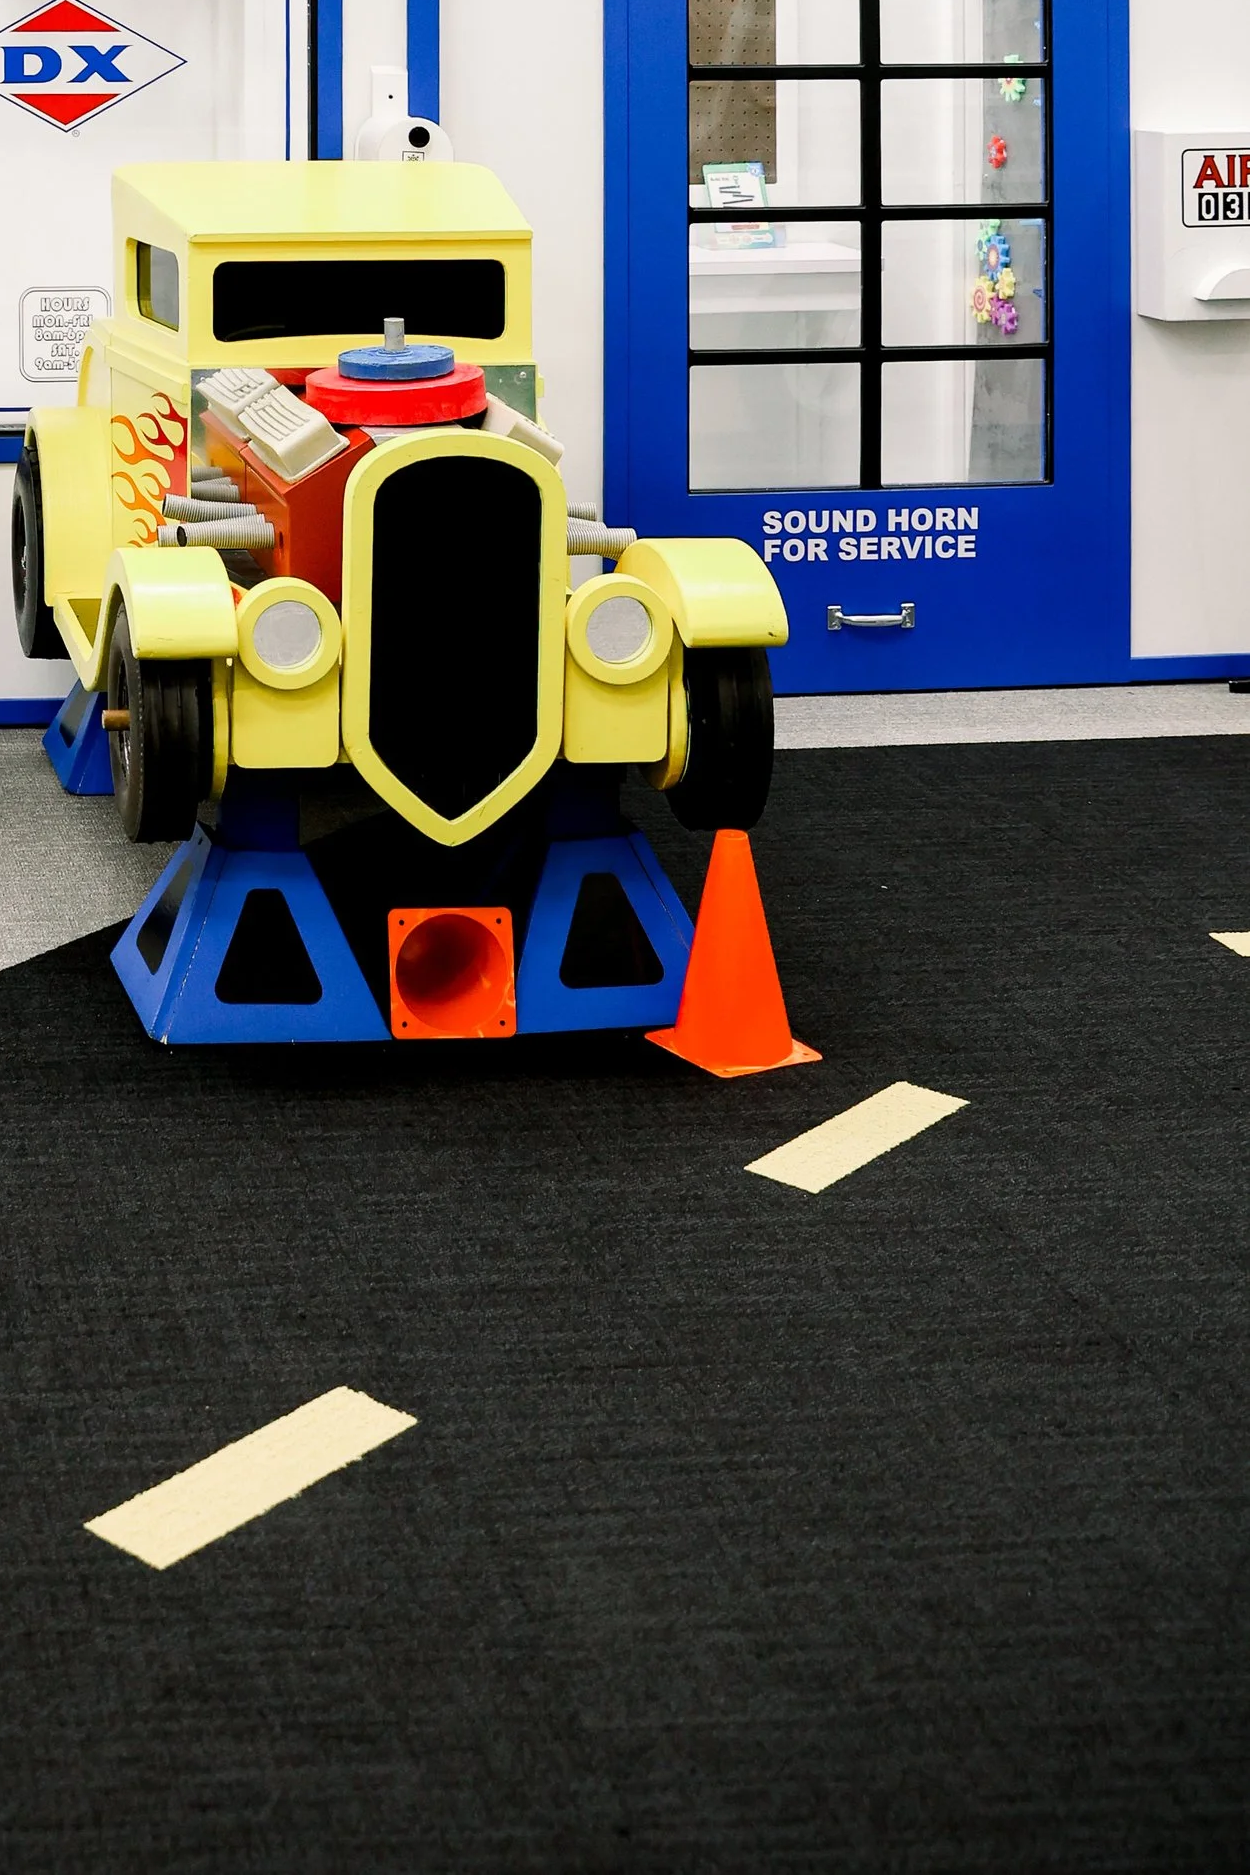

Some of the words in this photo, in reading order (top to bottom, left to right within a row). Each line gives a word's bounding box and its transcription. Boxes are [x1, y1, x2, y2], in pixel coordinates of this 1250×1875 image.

[0, 44, 134, 85] DX
[40, 296, 90, 312] HOURS
[34, 327, 87, 343] 8am-6p
[51, 343, 80, 357] SAT.
[762, 509, 877, 535] SOUND
[887, 507, 979, 532] HORN
[764, 538, 829, 563] FOR
[838, 535, 977, 561] SERVICE
